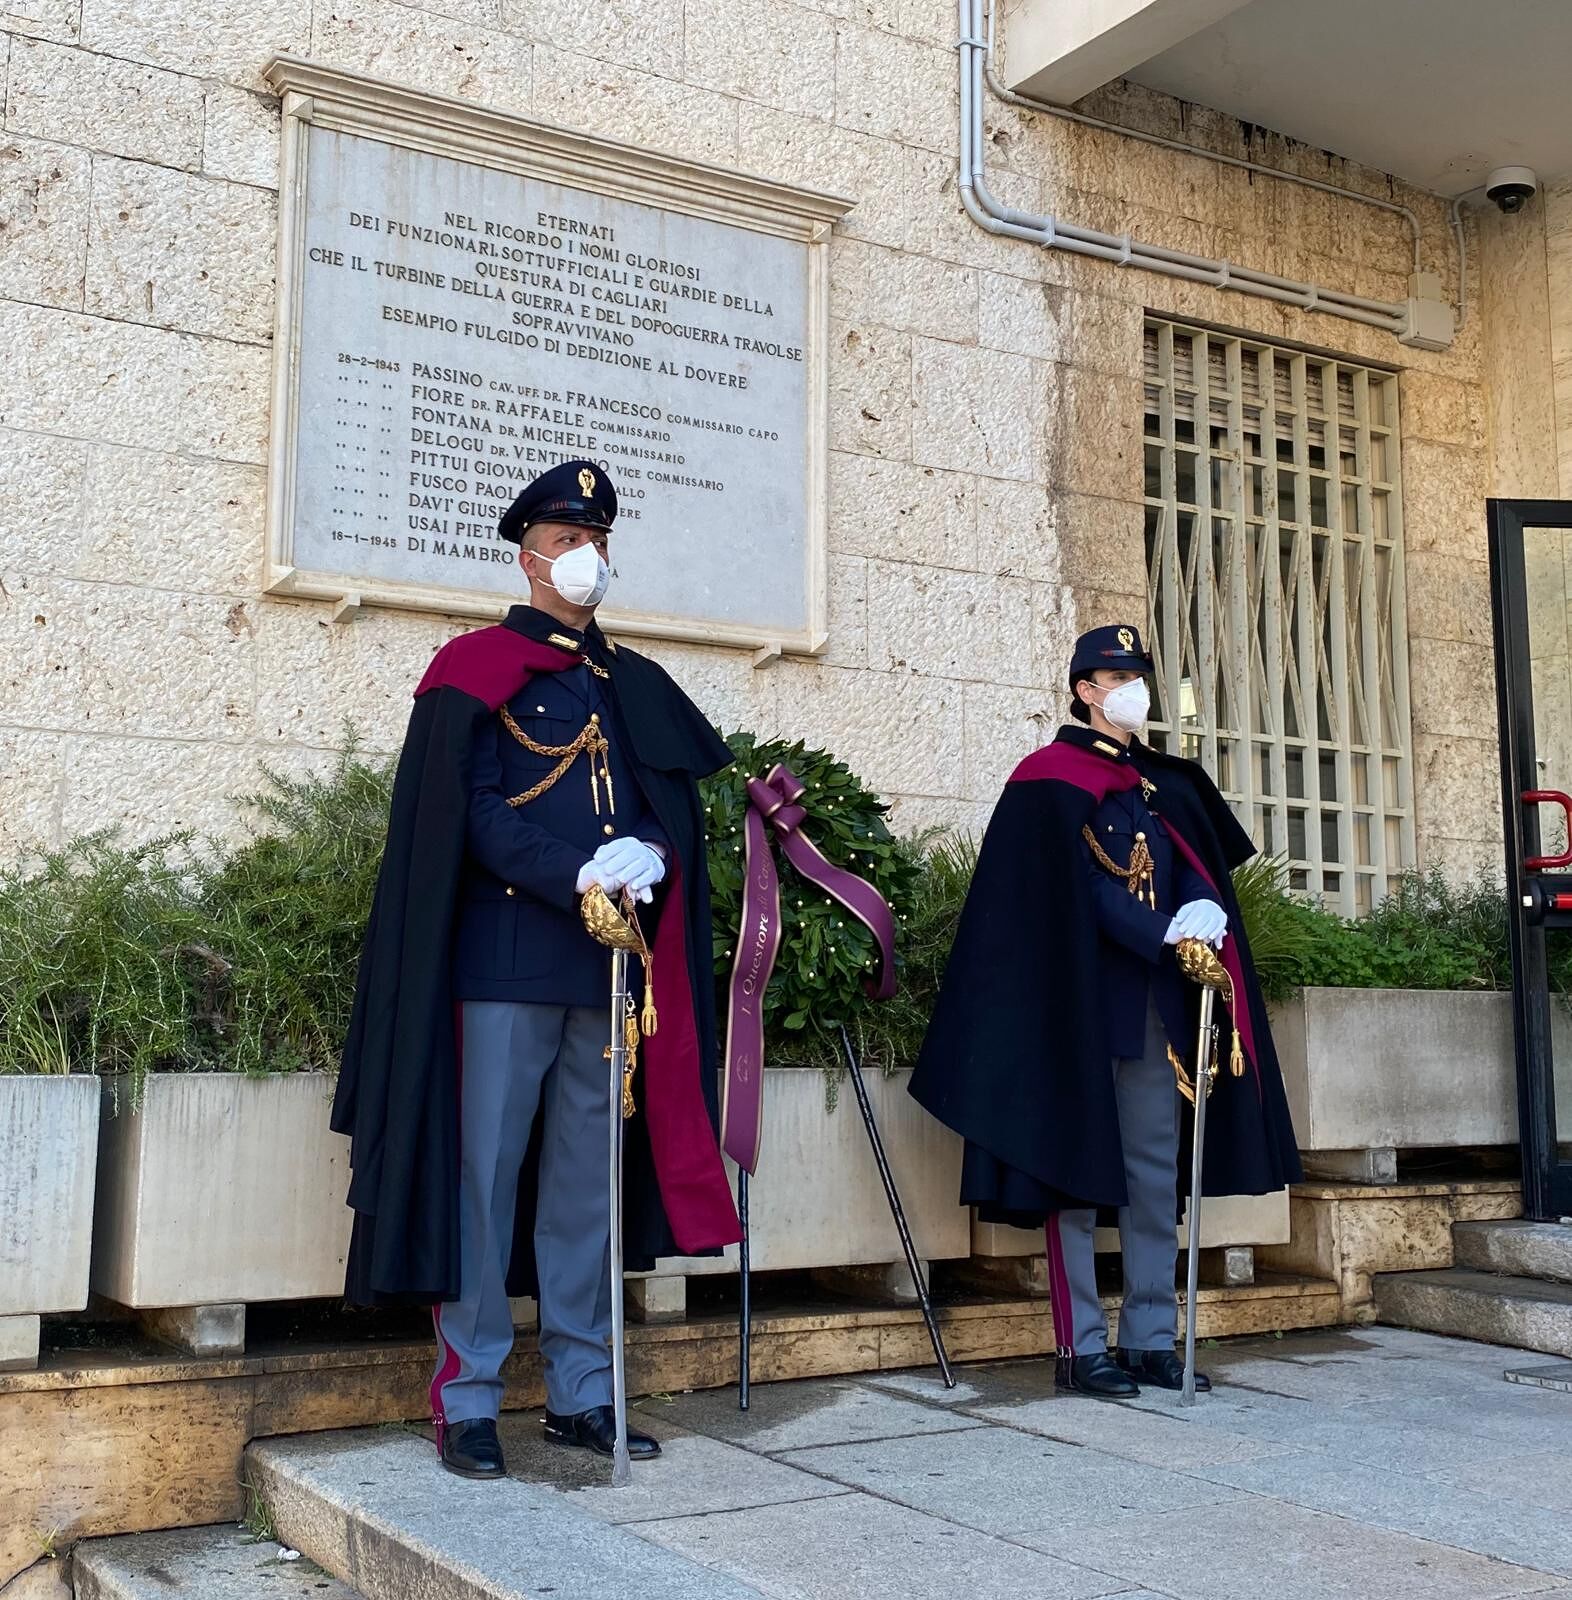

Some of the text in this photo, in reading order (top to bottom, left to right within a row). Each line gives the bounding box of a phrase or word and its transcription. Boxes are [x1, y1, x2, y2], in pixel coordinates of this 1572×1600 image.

[444, 212, 700, 281] NEL RICORDO I NOMI GLORIOSI
[537, 212, 615, 242] ETERNATI
[350, 211, 380, 232] DEI
[501, 248, 628, 286] SOTTUFFICIALI
[634, 273, 644, 290] E
[649, 277, 717, 304] GUARDIE
[723, 294, 774, 317] DELLA
[475, 261, 667, 314] QUESTURA DI CAGLIARI
[308, 247, 803, 362] CHE IL TURBINE DELLA GUERRA E DEL DOPOGUERRA TRAVOLSE
[512, 312, 634, 347] SOPRAVVIVANO
[382, 305, 748, 390] ESEMPIO FULGIDO DI DEDIZIONE AL DOVERE
[337, 353, 779, 442] 28-2-1943 PASSINO CAV. UFF. DR. FRANCESCO COMMISSARIO CAPO
[411, 385, 671, 442] FIORE DR. RAFFAELE COMMISSARIO
[410, 450, 468, 472] PITTUI
[411, 407, 686, 465] FONTANA DR. MICHELE COMMISSARIO
[411, 427, 484, 453] DELOGU
[490, 444, 509, 457] DR.
[615, 465, 641, 479] VICE
[647, 471, 724, 492] COMMISSARIO
[410, 472, 522, 501] FUSCO PAOL
[332, 531, 514, 565] 18-1-1945 DI MAMBRO
[408, 515, 448, 535] USAI
[742, 912, 769, 996] Questore
